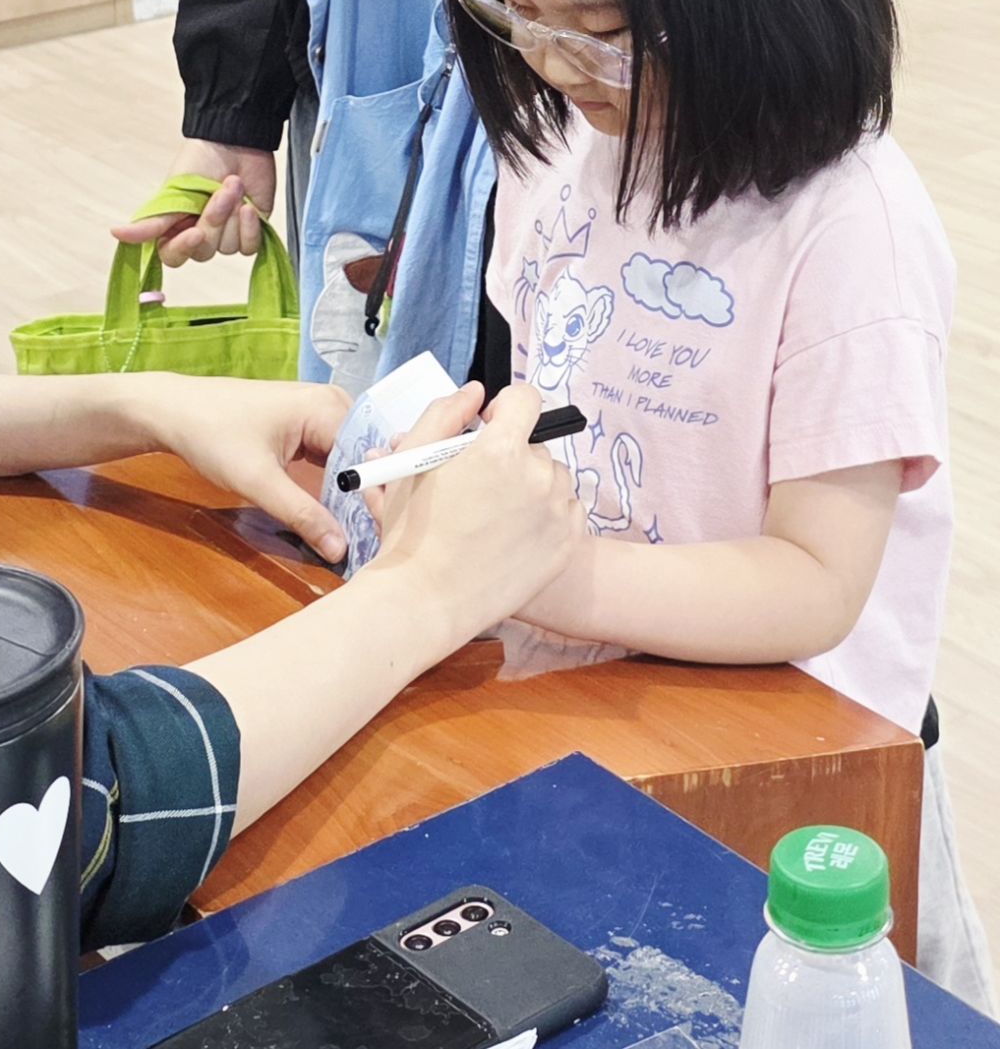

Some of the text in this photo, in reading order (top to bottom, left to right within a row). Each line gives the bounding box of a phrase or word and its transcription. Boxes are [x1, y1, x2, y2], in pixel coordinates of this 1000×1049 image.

[616, 328, 711, 369] I LOVE YOU
[627, 364, 673, 389] MORE
[591, 382, 719, 426] THAN I PLANNED
[803, 832, 840, 872] TREVI
